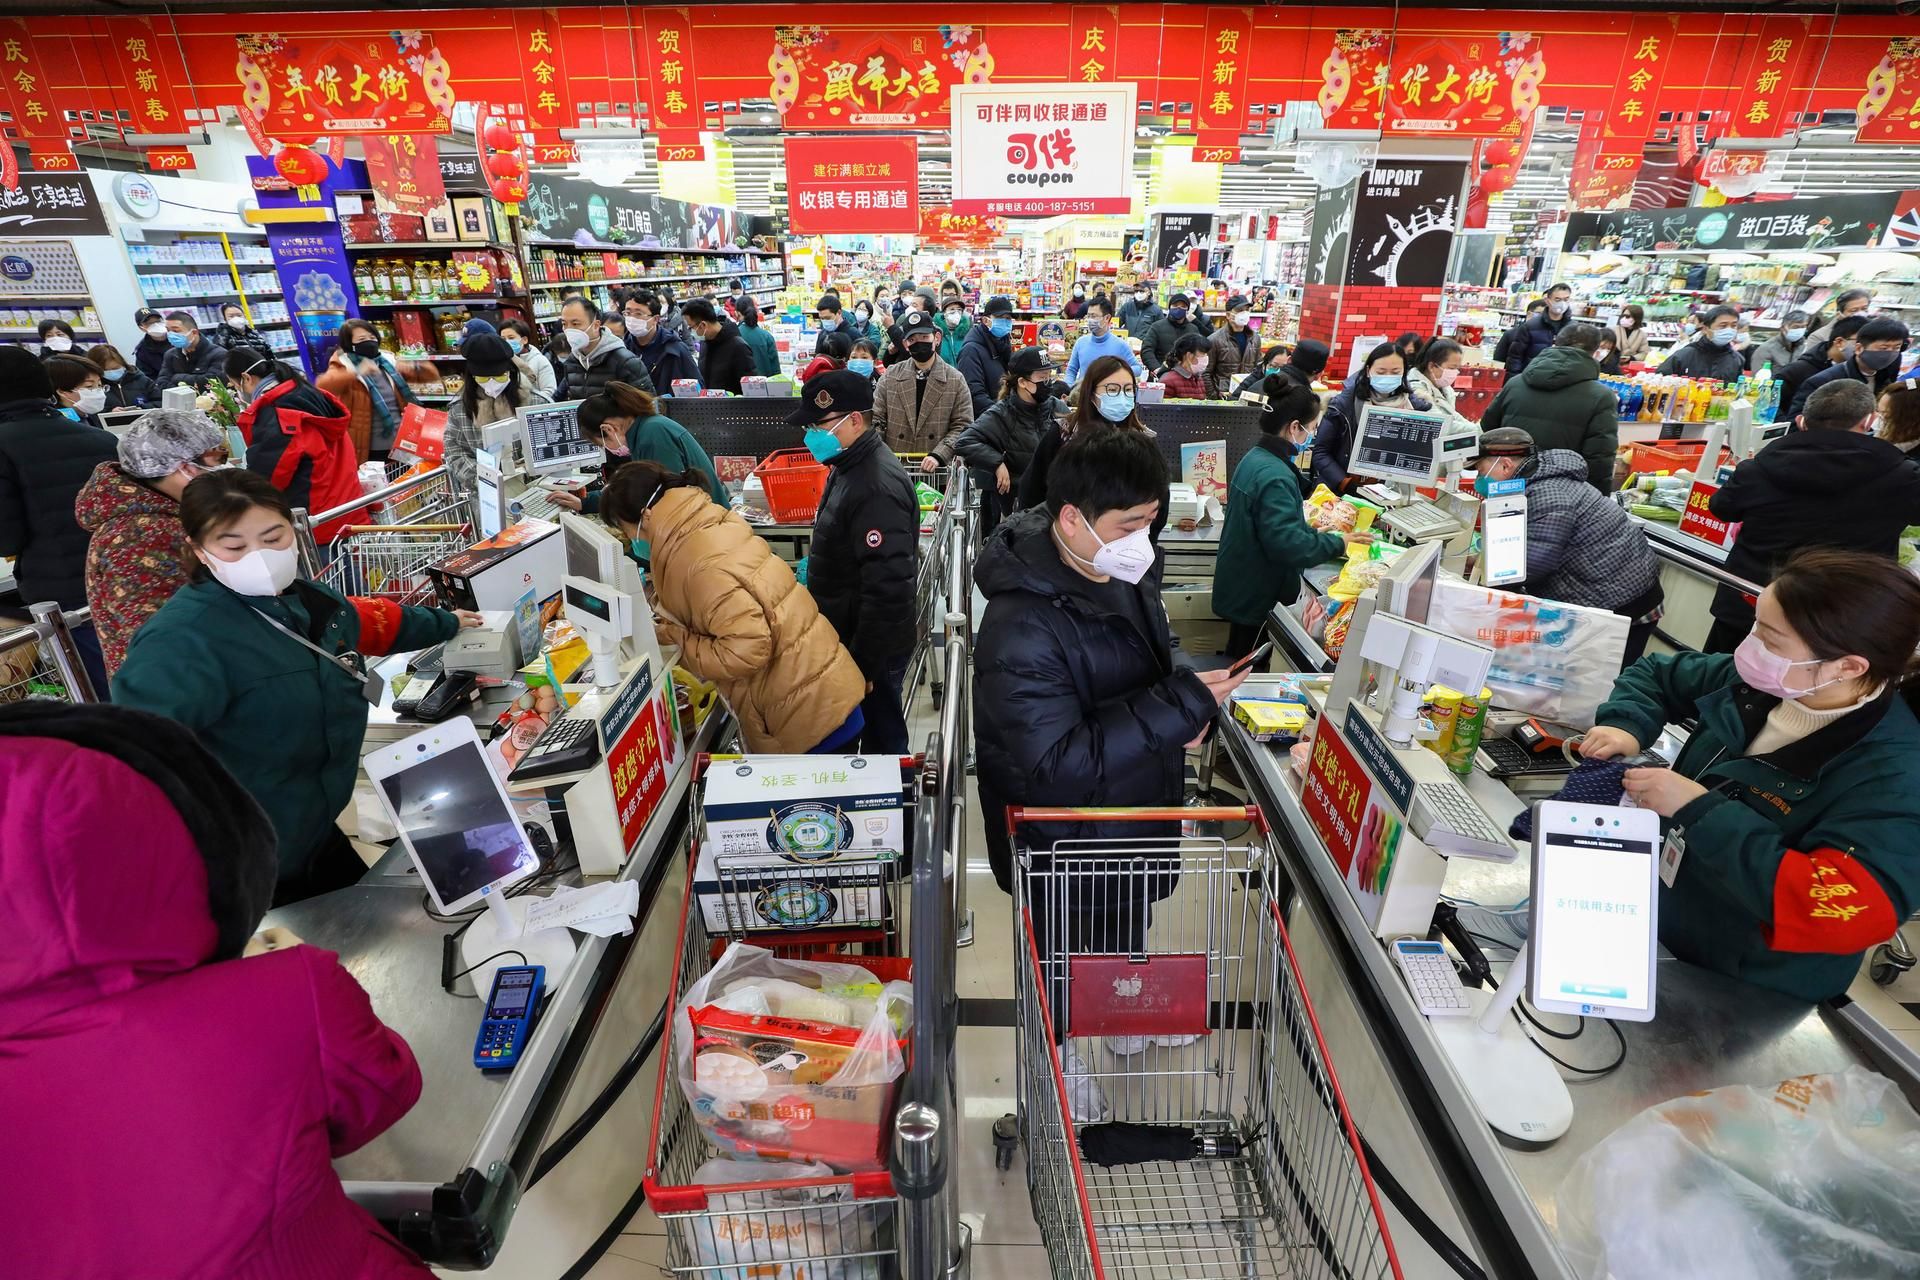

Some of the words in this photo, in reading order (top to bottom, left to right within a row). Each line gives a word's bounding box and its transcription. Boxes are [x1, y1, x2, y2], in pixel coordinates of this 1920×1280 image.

[3, 37, 48, 124] 庆余年
[125, 36, 170, 123] 贺新春
[284, 64, 410, 108] 年货大街
[528, 29, 561, 114] 庆余年
[656, 28, 688, 114] 贺新春
[823, 55, 941, 111] 鼠年大吉
[1209, 28, 1241, 115] 贺新春
[1363, 61, 1499, 106] 年货大街
[1618, 36, 1661, 122] 庆余年
[1744, 37, 1794, 125] 贺新春
[977, 102, 1108, 122] 可伴网收银通道
[813, 163, 891, 177] 建行满额立减
[1007, 127, 1077, 170] 可伴
[31, 182, 87, 209] 乐享生活!
[799, 189, 908, 210] 收银专用通道
[1007, 172, 1074, 188] coupon
[1366, 187, 1401, 197] 进口商品
[1367, 169, 1423, 186] IMPORT
[615, 206, 653, 234] 进口食品
[987, 203, 1022, 212] 客服电话
[1025, 202, 1095, 212] 400-187-5151
[1165, 216, 1192, 226] IMPORT
[1737, 214, 1811, 239] 进口百货
[1685, 511, 1726, 533] 请您文明排队
[613, 721, 657, 801] 遵德守礼
[1313, 732, 1363, 824] 遵德守礼
[1350, 716, 1407, 798] 需积分请出示您的会员卡
[621, 757, 661, 828] 请您文明排队
[1307, 770, 1352, 852] 请您文明排队
[1556, 898, 1638, 916] 支付就用支付宝
